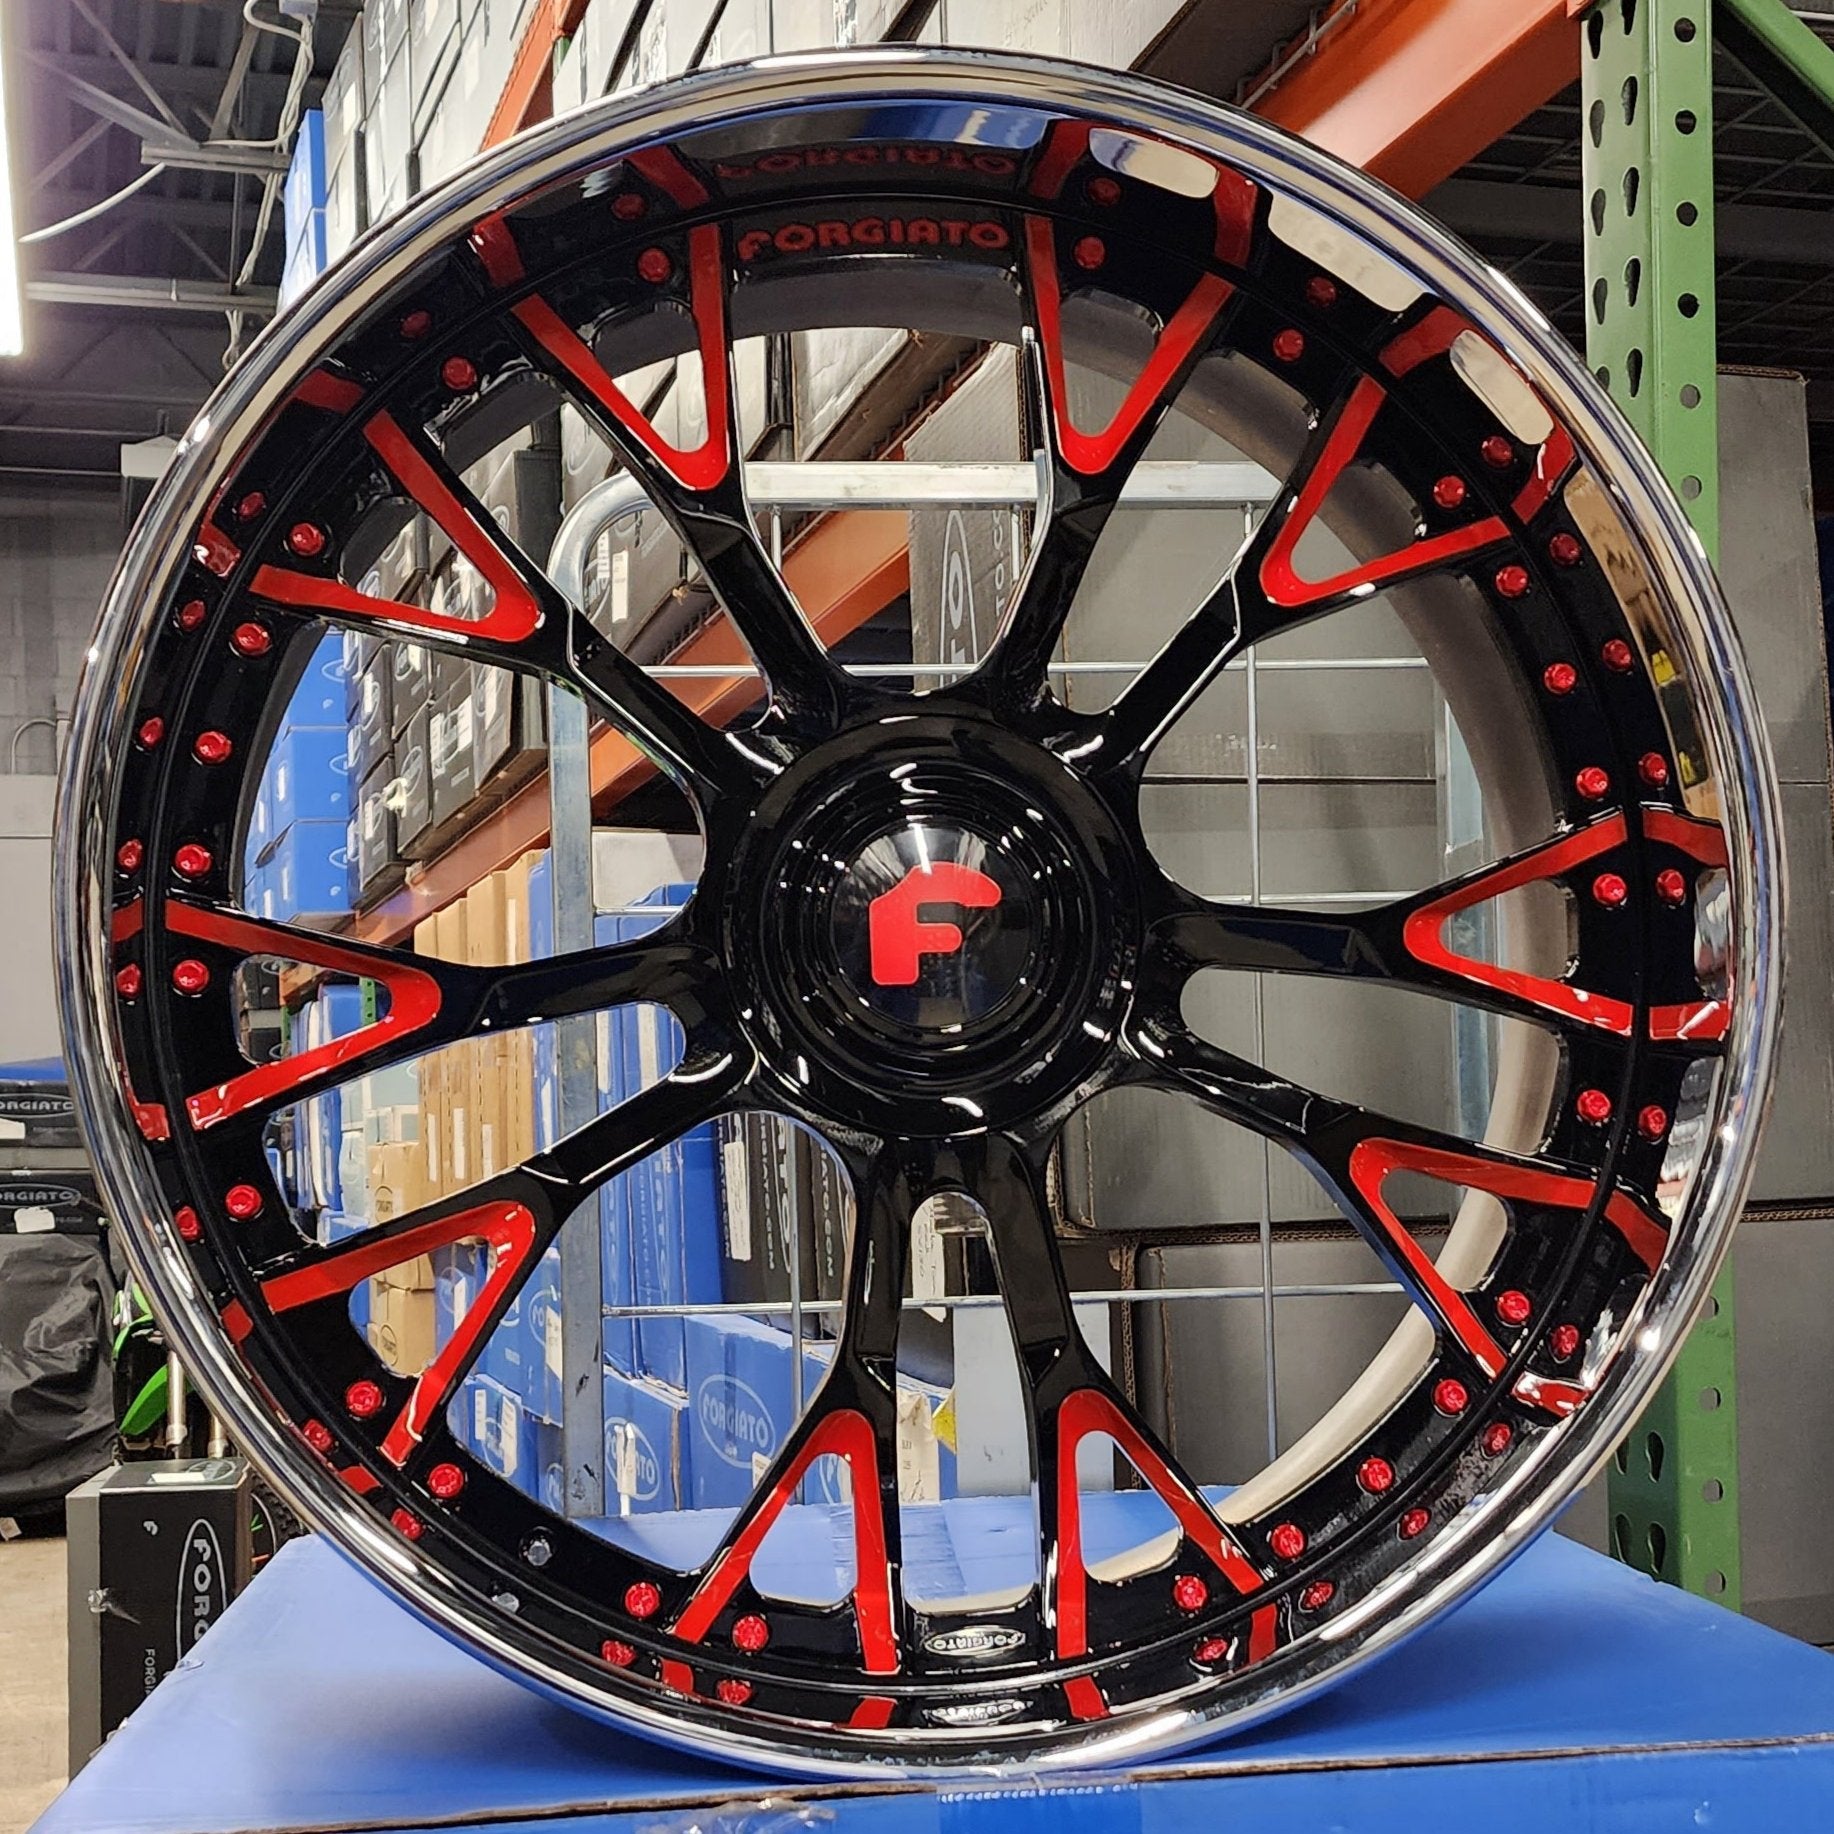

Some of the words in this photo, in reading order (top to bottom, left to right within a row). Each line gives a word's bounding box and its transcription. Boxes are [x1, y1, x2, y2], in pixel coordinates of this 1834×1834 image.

[737, 217, 1010, 261] FORGIATO
[869, 861, 1002, 986] F
[702, 1392, 769, 1449] FORGIATO
